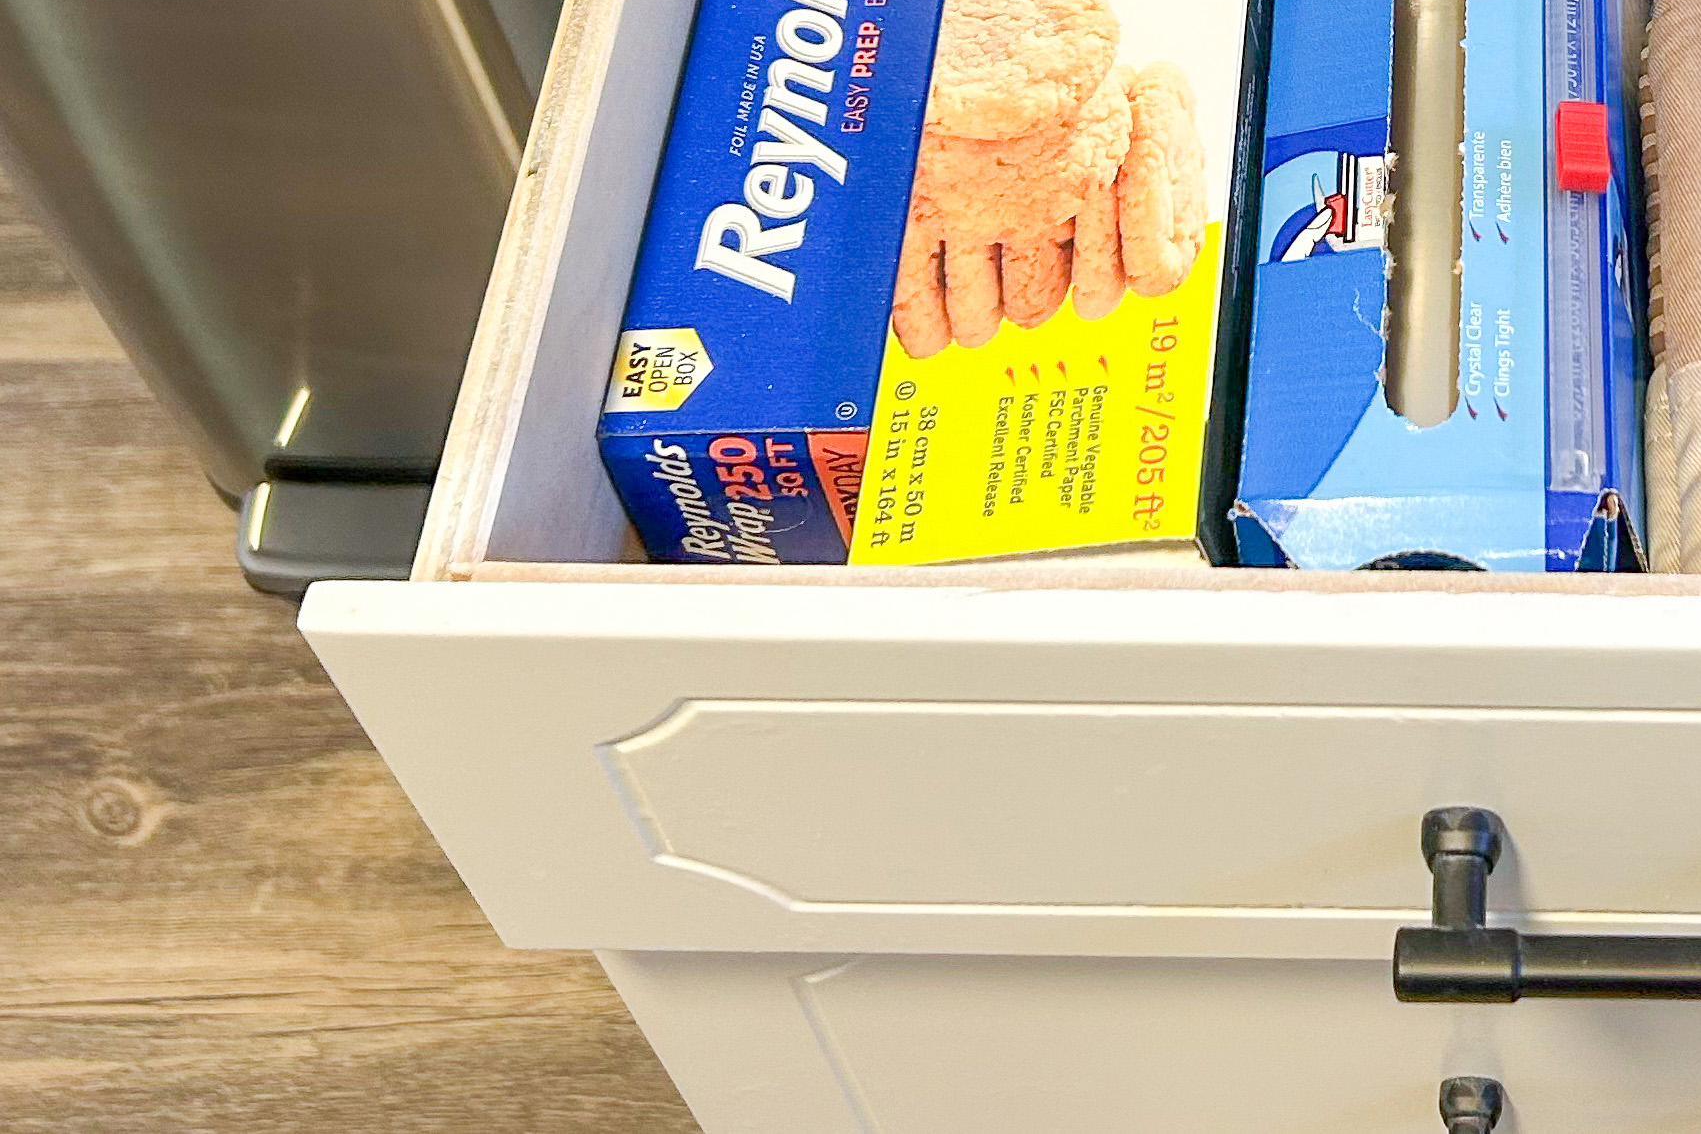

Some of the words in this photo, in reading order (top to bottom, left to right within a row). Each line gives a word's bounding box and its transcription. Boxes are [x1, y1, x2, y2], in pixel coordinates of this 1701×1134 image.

[750, 35, 767, 63] USA
[746, 63, 758, 78] IN
[737, 80, 754, 120] MADE
[840, 84, 871, 133] EASY
[728, 122, 748, 157] FOIL
[1500, 138, 1513, 171] bien
[1468, 130, 1487, 220] Transparente
[1496, 173, 1513, 224] Adhère
[1150, 316, 1180, 353] 19
[1467, 301, 1485, 339] Clear
[1495, 308, 1516, 340] Tight
[621, 341, 652, 398] EASY
[647, 346, 676, 393] OPEN
[673, 351, 699, 386] BOX
[1465, 341, 1485, 398] Crystal
[1493, 342, 1516, 398] Clings
[889, 408, 911, 434] 15
[916, 404, 939, 433] 38
[1018, 392, 1040, 442] Kosher
[1048, 389, 1068, 418] FSC
[1087, 384, 1109, 442] Genuine
[990, 395, 1015, 459] Excellent
[1064, 387, 1090, 463] Parchment
[707, 435, 774, 502] 250
[764, 437, 799, 469] FT
[885, 437, 908, 462] in
[910, 435, 930, 471] cm
[1040, 420, 1063, 479] Certified
[774, 471, 809, 498] SQ
[823, 448, 864, 528] RYDAY
[881, 466, 897, 483] x
[908, 471, 924, 487] x
[982, 461, 1006, 518] Release
[1009, 444, 1033, 505] Certified
[1058, 466, 1081, 509] Paper
[1079, 443, 1102, 515] Vegetable
[644, 438, 734, 561] Reynolds
[873, 484, 898, 526] 164
[903, 489, 925, 518] 50
[726, 502, 781, 565] Wrap
[870, 529, 891, 550] ft
[899, 520, 917, 545] m
